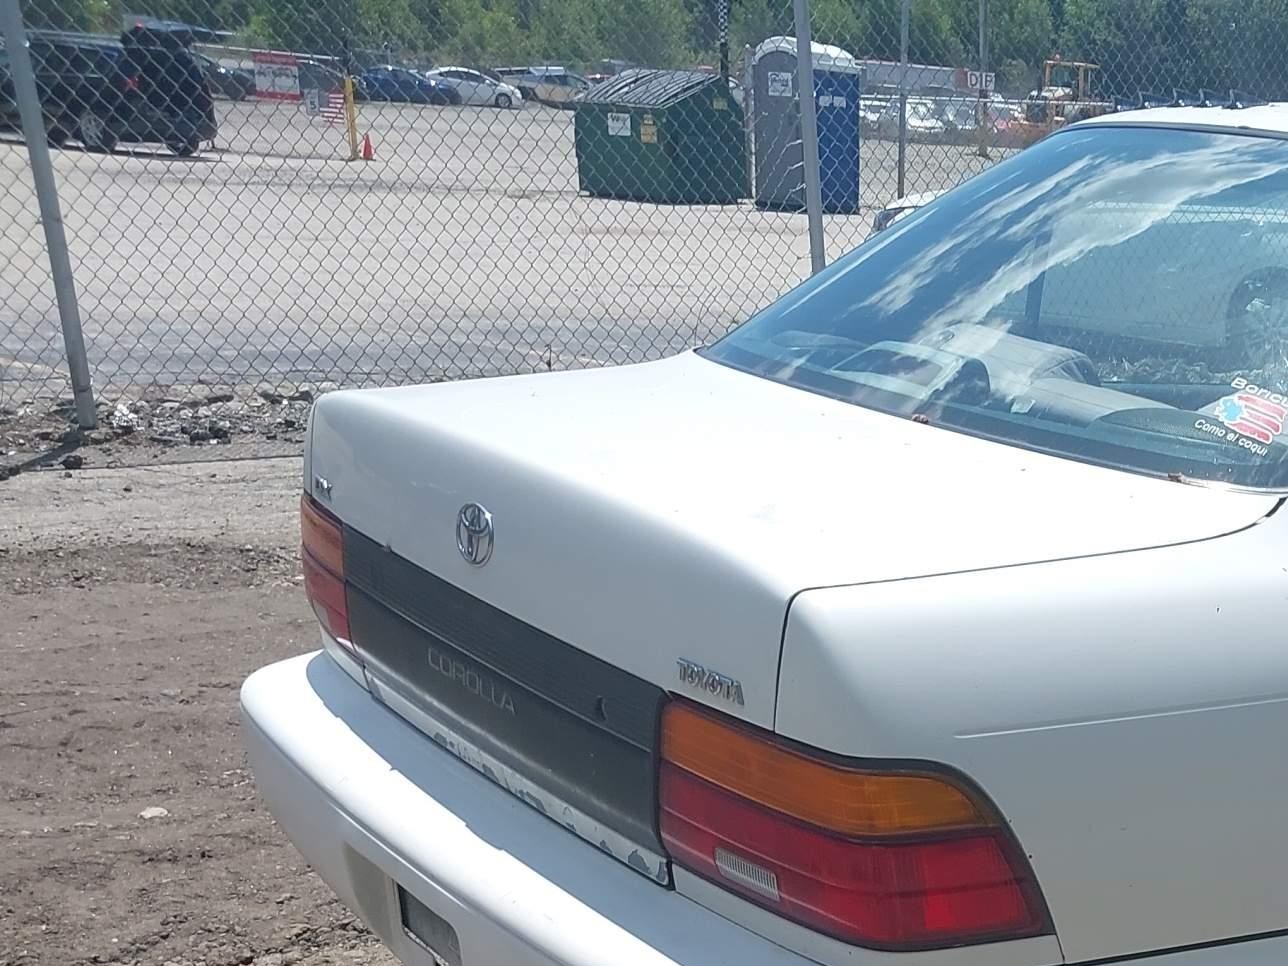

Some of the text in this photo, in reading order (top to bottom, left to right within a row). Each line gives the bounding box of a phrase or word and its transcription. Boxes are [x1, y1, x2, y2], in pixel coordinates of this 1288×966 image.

[1194, 418, 1226, 438] Como
[1227, 431, 1239, 442] el
[426, 646, 517, 716] COROLLA
[676, 656, 744, 706] TOYOTA
